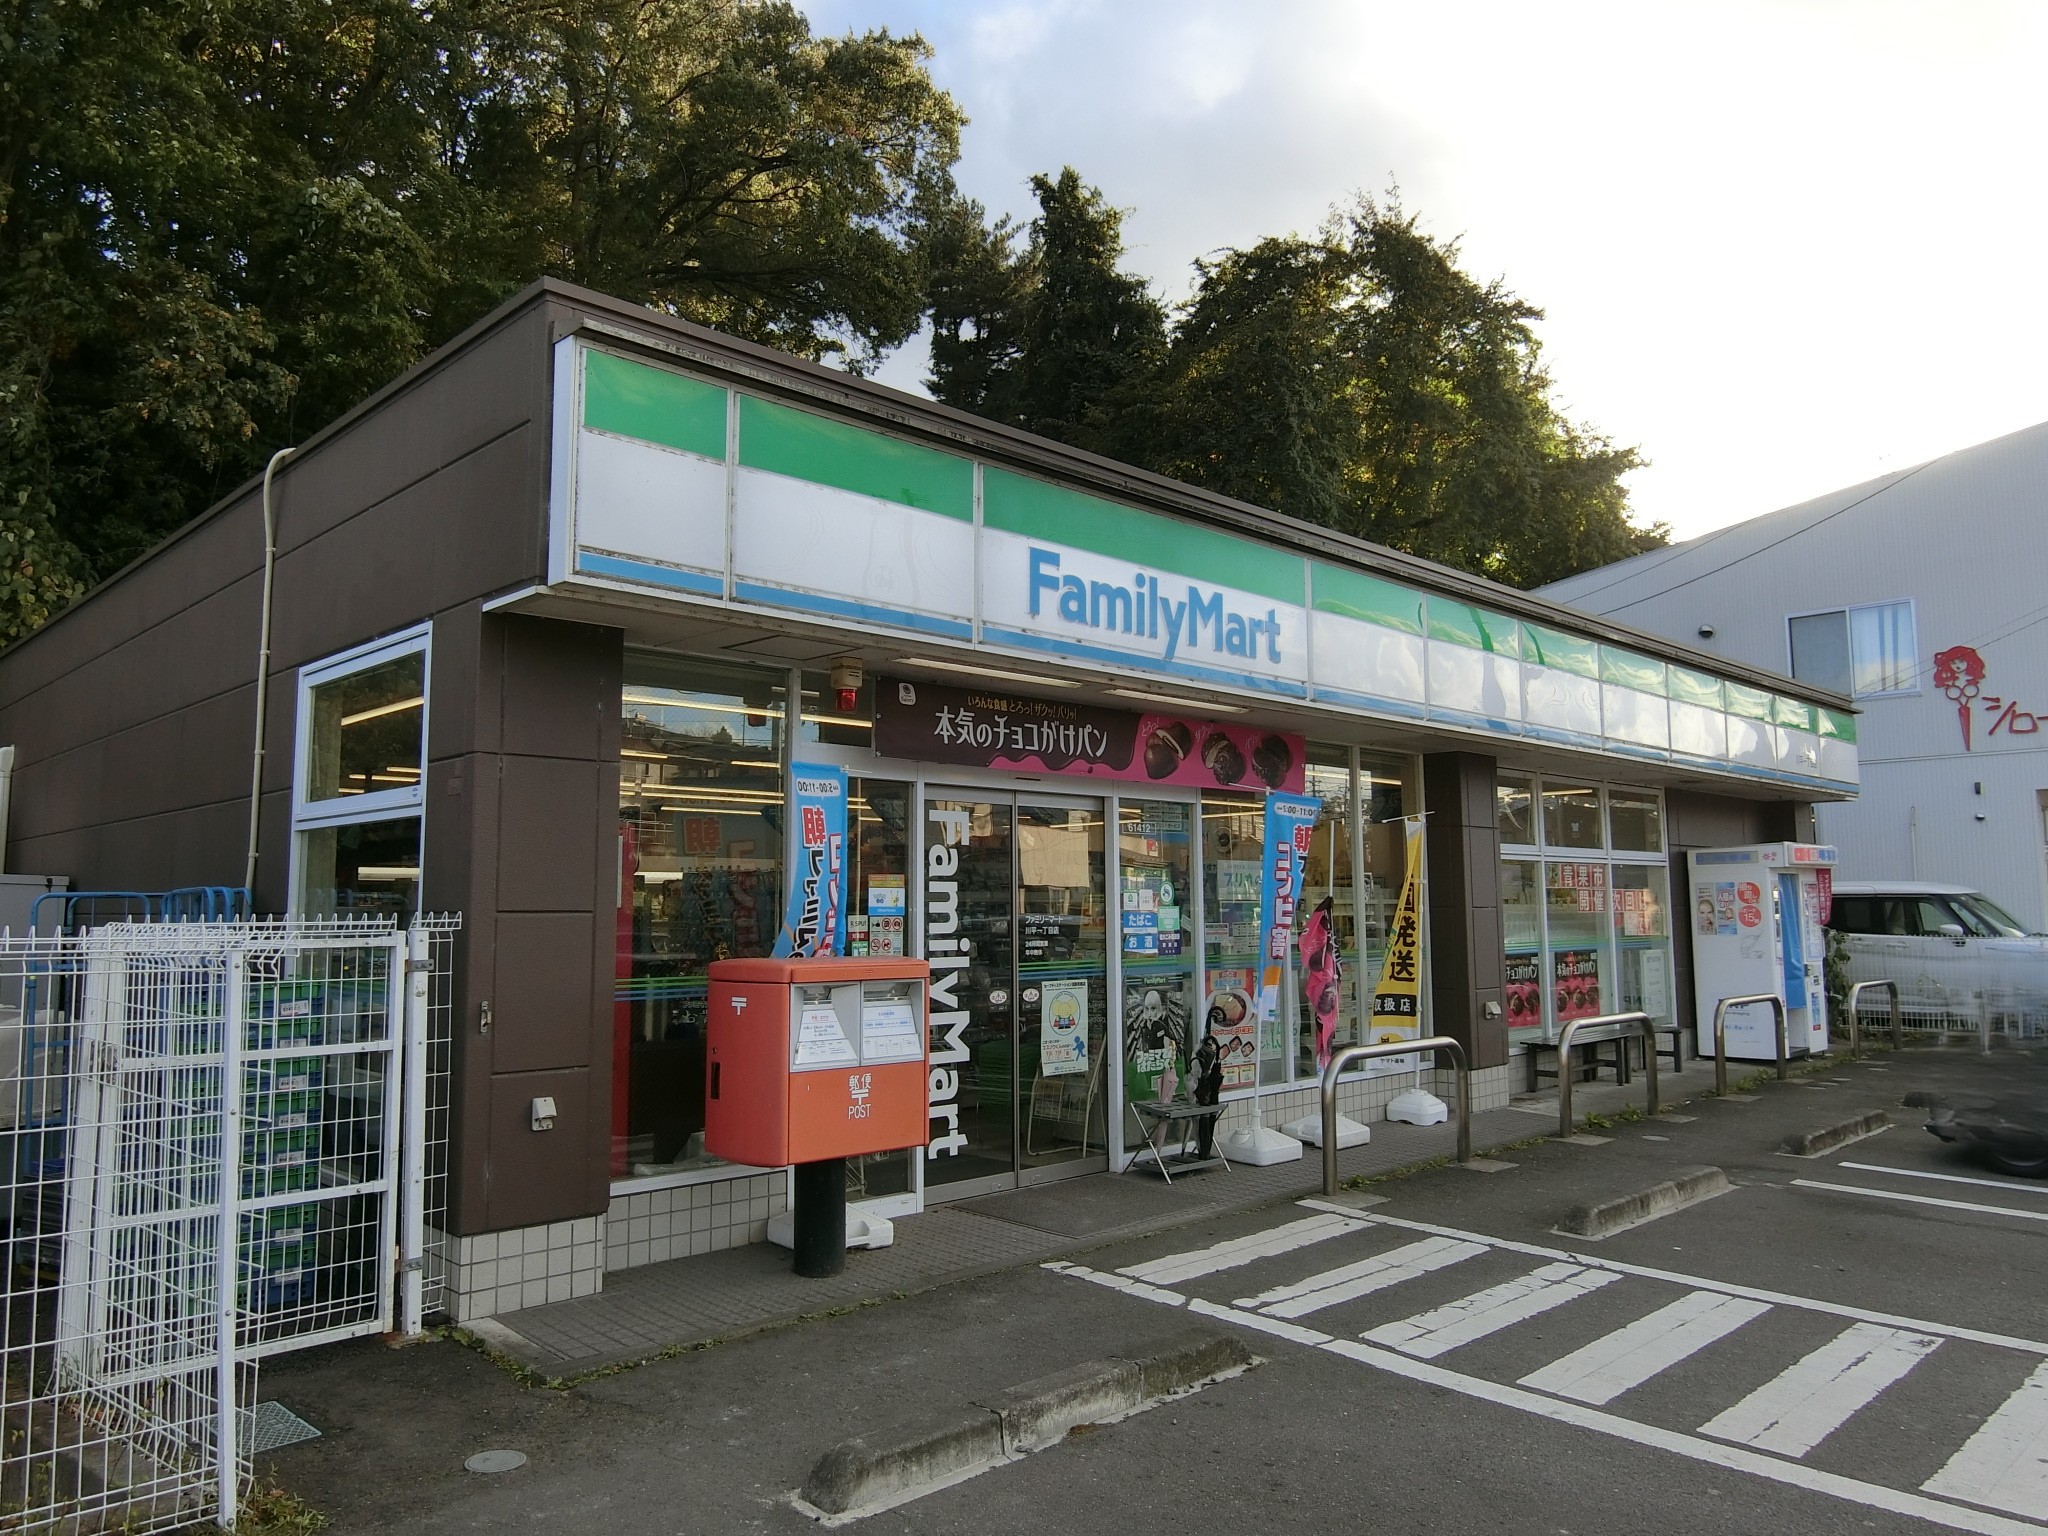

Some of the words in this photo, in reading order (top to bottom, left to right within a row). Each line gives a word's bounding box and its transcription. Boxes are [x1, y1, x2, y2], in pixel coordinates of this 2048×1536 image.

[1029, 546, 1281, 664] FamilyMart
[934, 705, 1107, 757] 本気のチョコがけパン
[1128, 823, 1151, 832] 61412
[1563, 864, 1603, 887] 青果市
[1579, 889, 1604, 911] 開催
[1025, 915, 1064, 924] ファミリーマート
[1128, 914, 1152, 926] たばこ
[929, 809, 971, 1160] FamilyMart
[1374, 998, 1411, 1013] 取扱店
[848, 1073, 872, 1092] 郵便
[848, 1104, 872, 1120] POST
